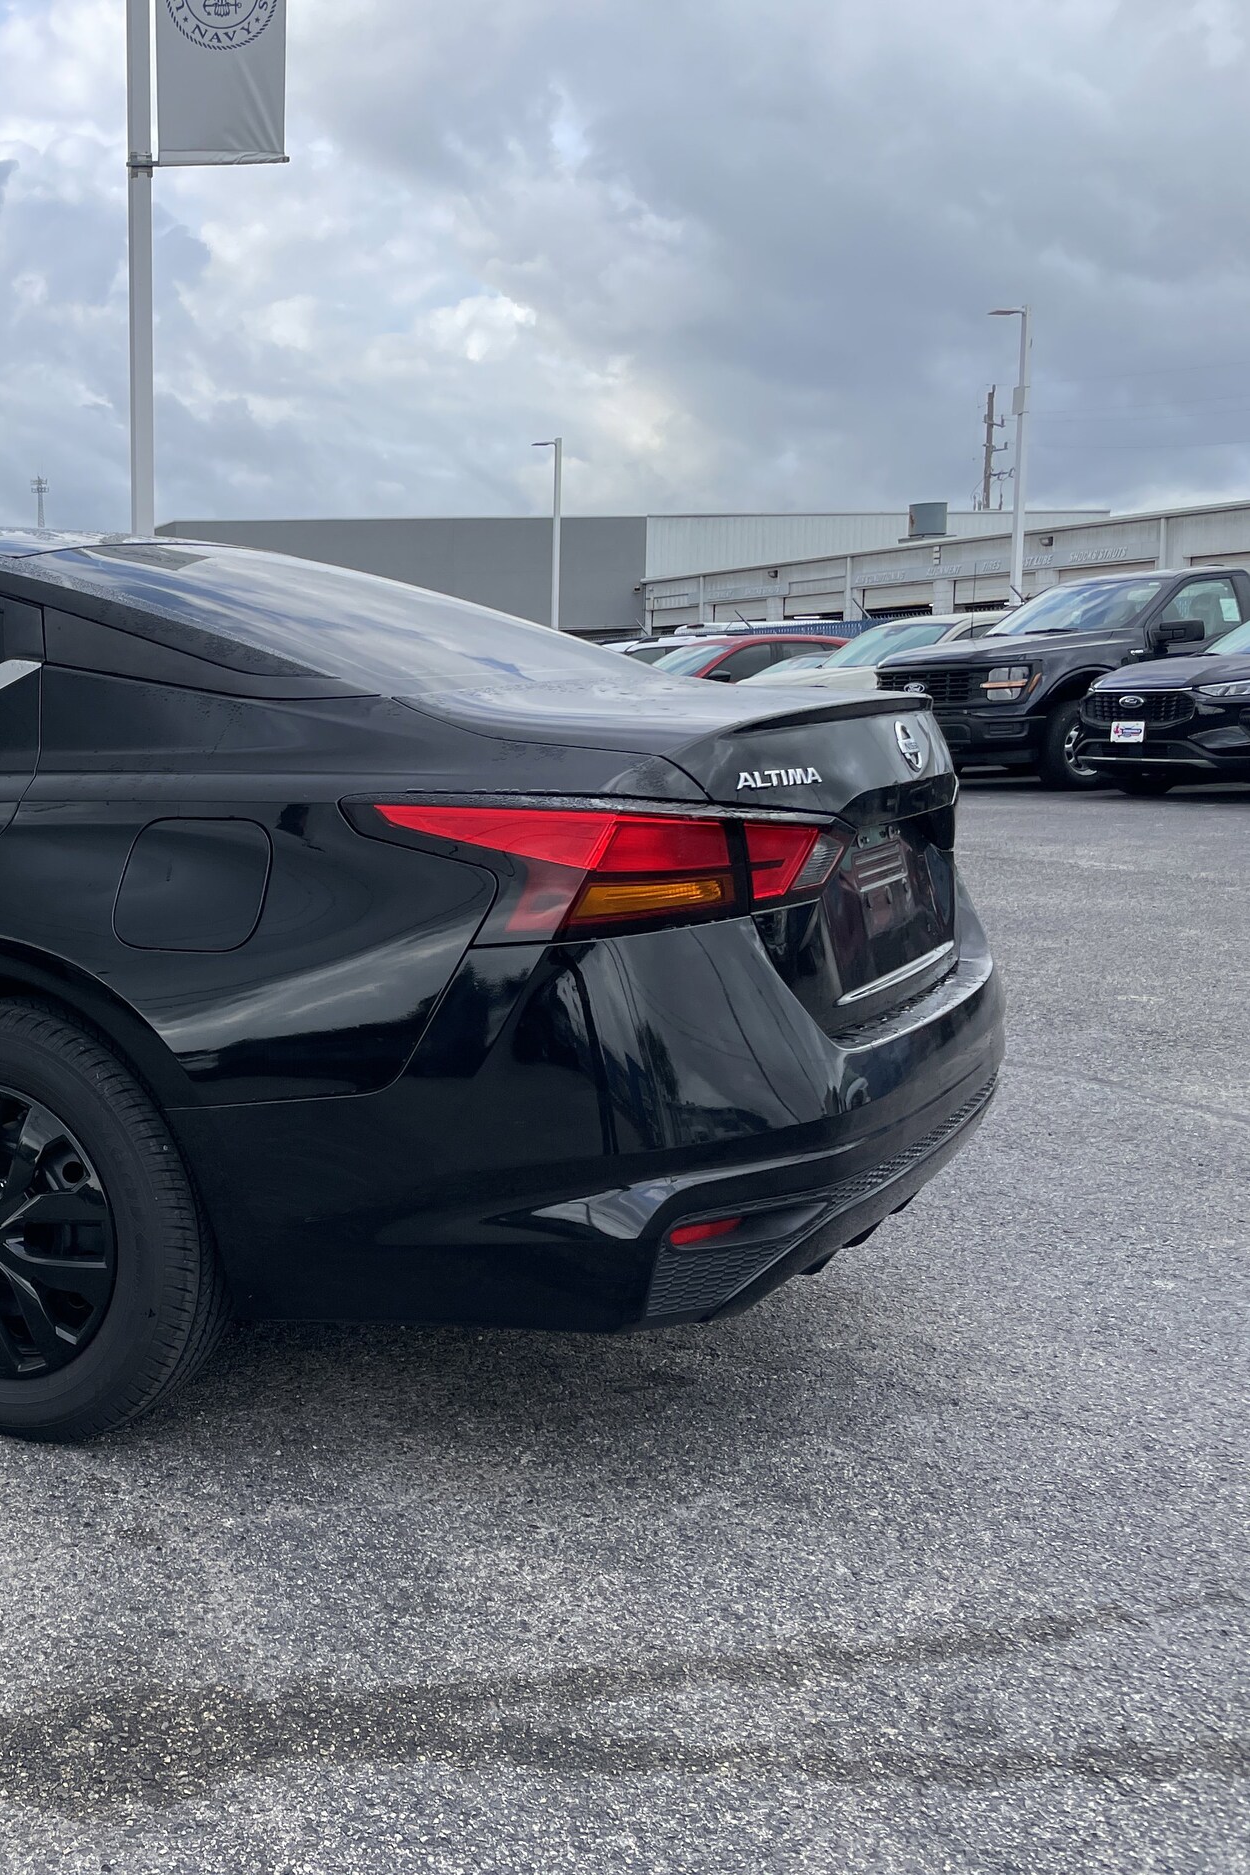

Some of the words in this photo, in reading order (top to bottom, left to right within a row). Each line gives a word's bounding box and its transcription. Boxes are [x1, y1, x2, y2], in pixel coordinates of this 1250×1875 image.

[191, 22, 252, 43] NAVY
[982, 560, 1001, 572] TIRES
[736, 767, 823, 790] ALTIMA
